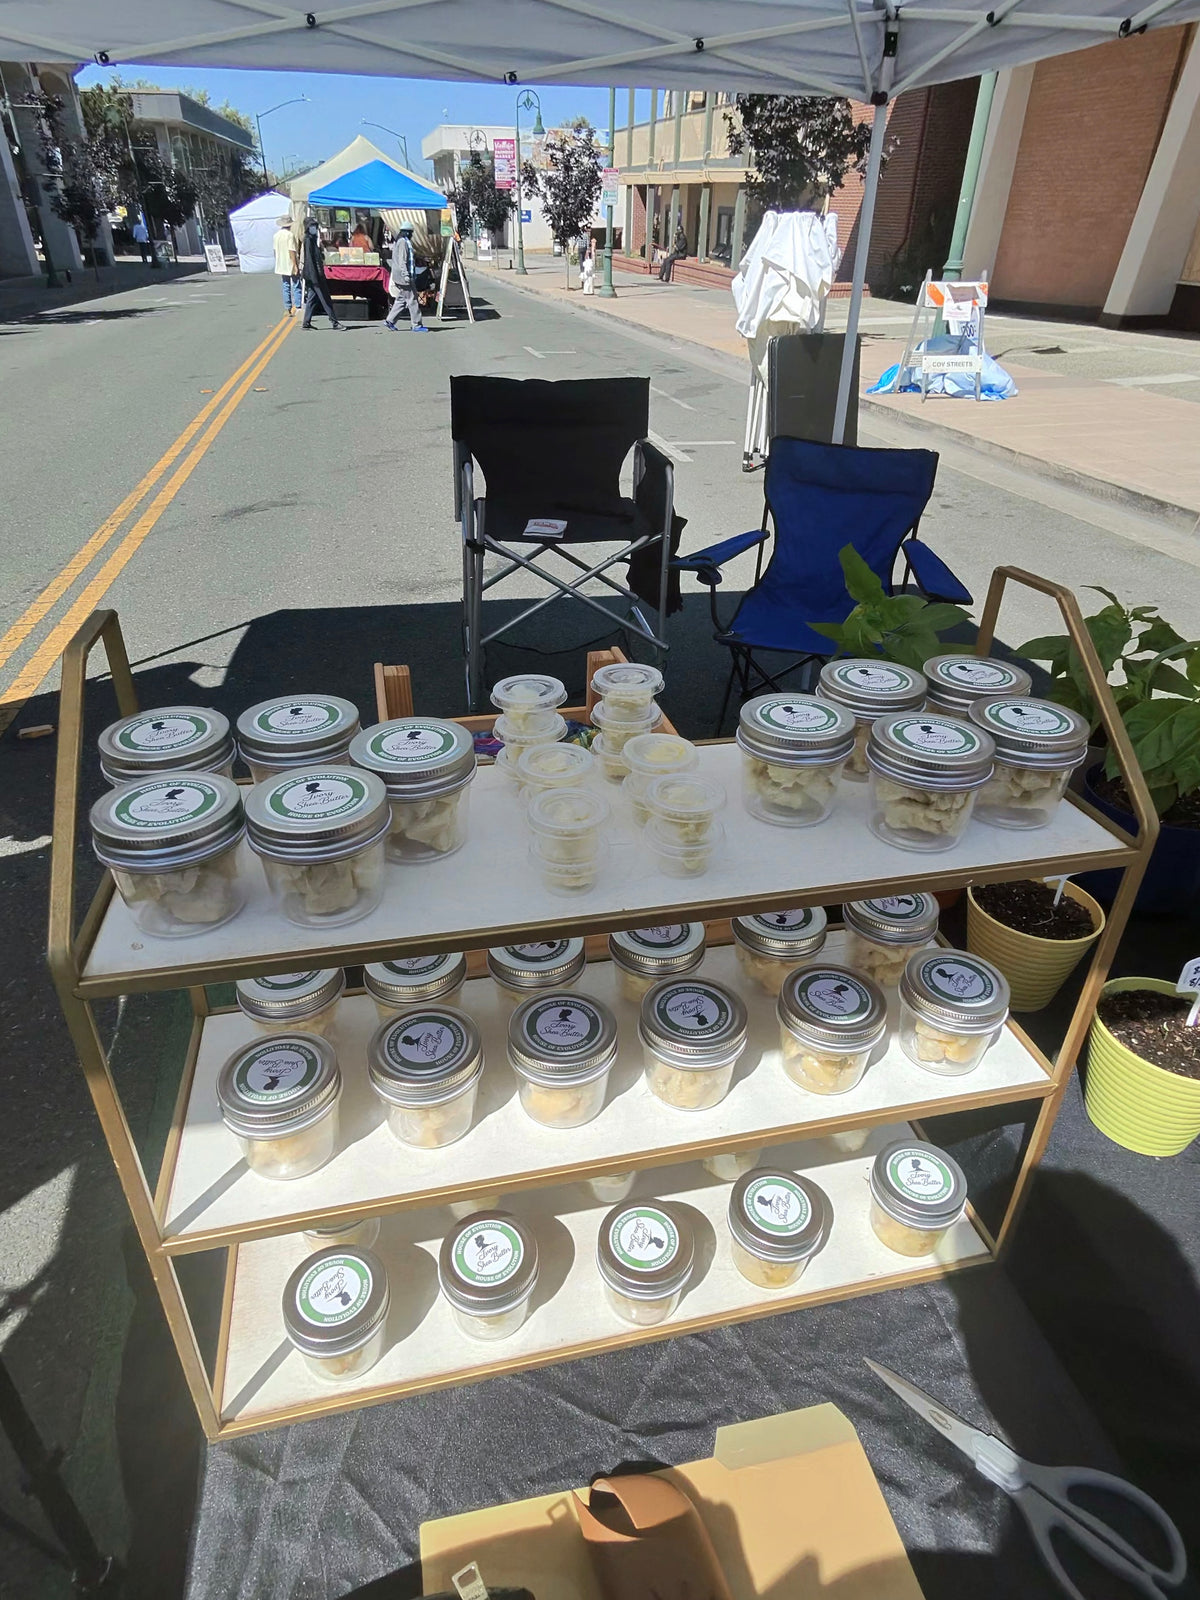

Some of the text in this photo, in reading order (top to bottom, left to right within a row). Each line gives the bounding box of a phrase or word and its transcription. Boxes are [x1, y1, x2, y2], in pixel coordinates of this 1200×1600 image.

[294, 794, 349, 810] Shea Butter
[302, 791, 335, 802] Ivory
[476, 1247, 512, 1273] Shea Butter
[478, 1245, 498, 1260] Ivory
[310, 1267, 345, 1300] Shea Butter
[324, 1279, 345, 1299] Ivory
